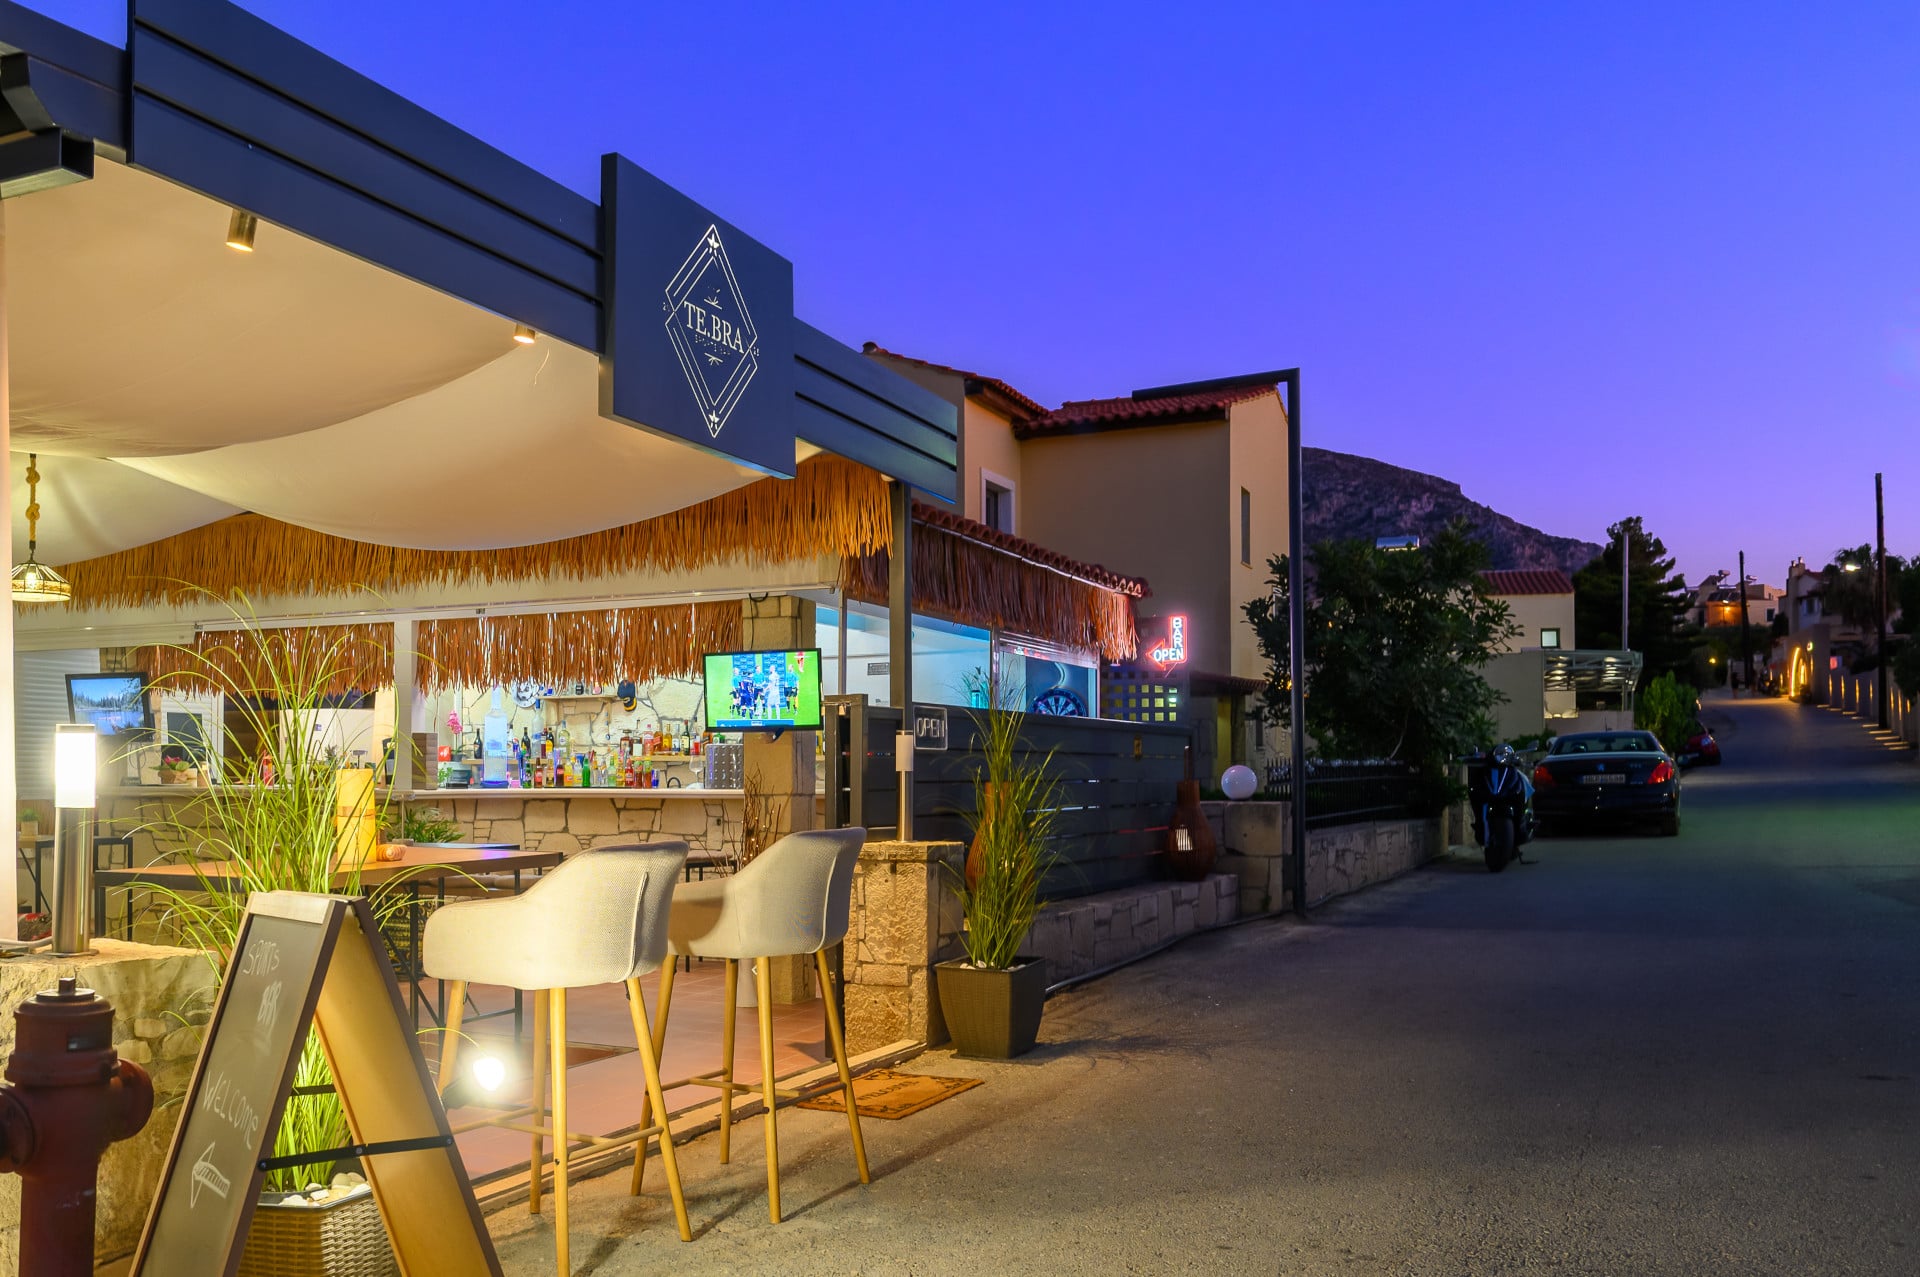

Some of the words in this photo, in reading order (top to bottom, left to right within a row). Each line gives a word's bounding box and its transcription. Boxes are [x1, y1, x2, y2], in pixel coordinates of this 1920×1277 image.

[683, 300, 744, 354] TE.BRA
[1172, 616, 1183, 648] BAR
[1153, 647, 1184, 662] OPEN
[916, 717, 945, 738] OPEN
